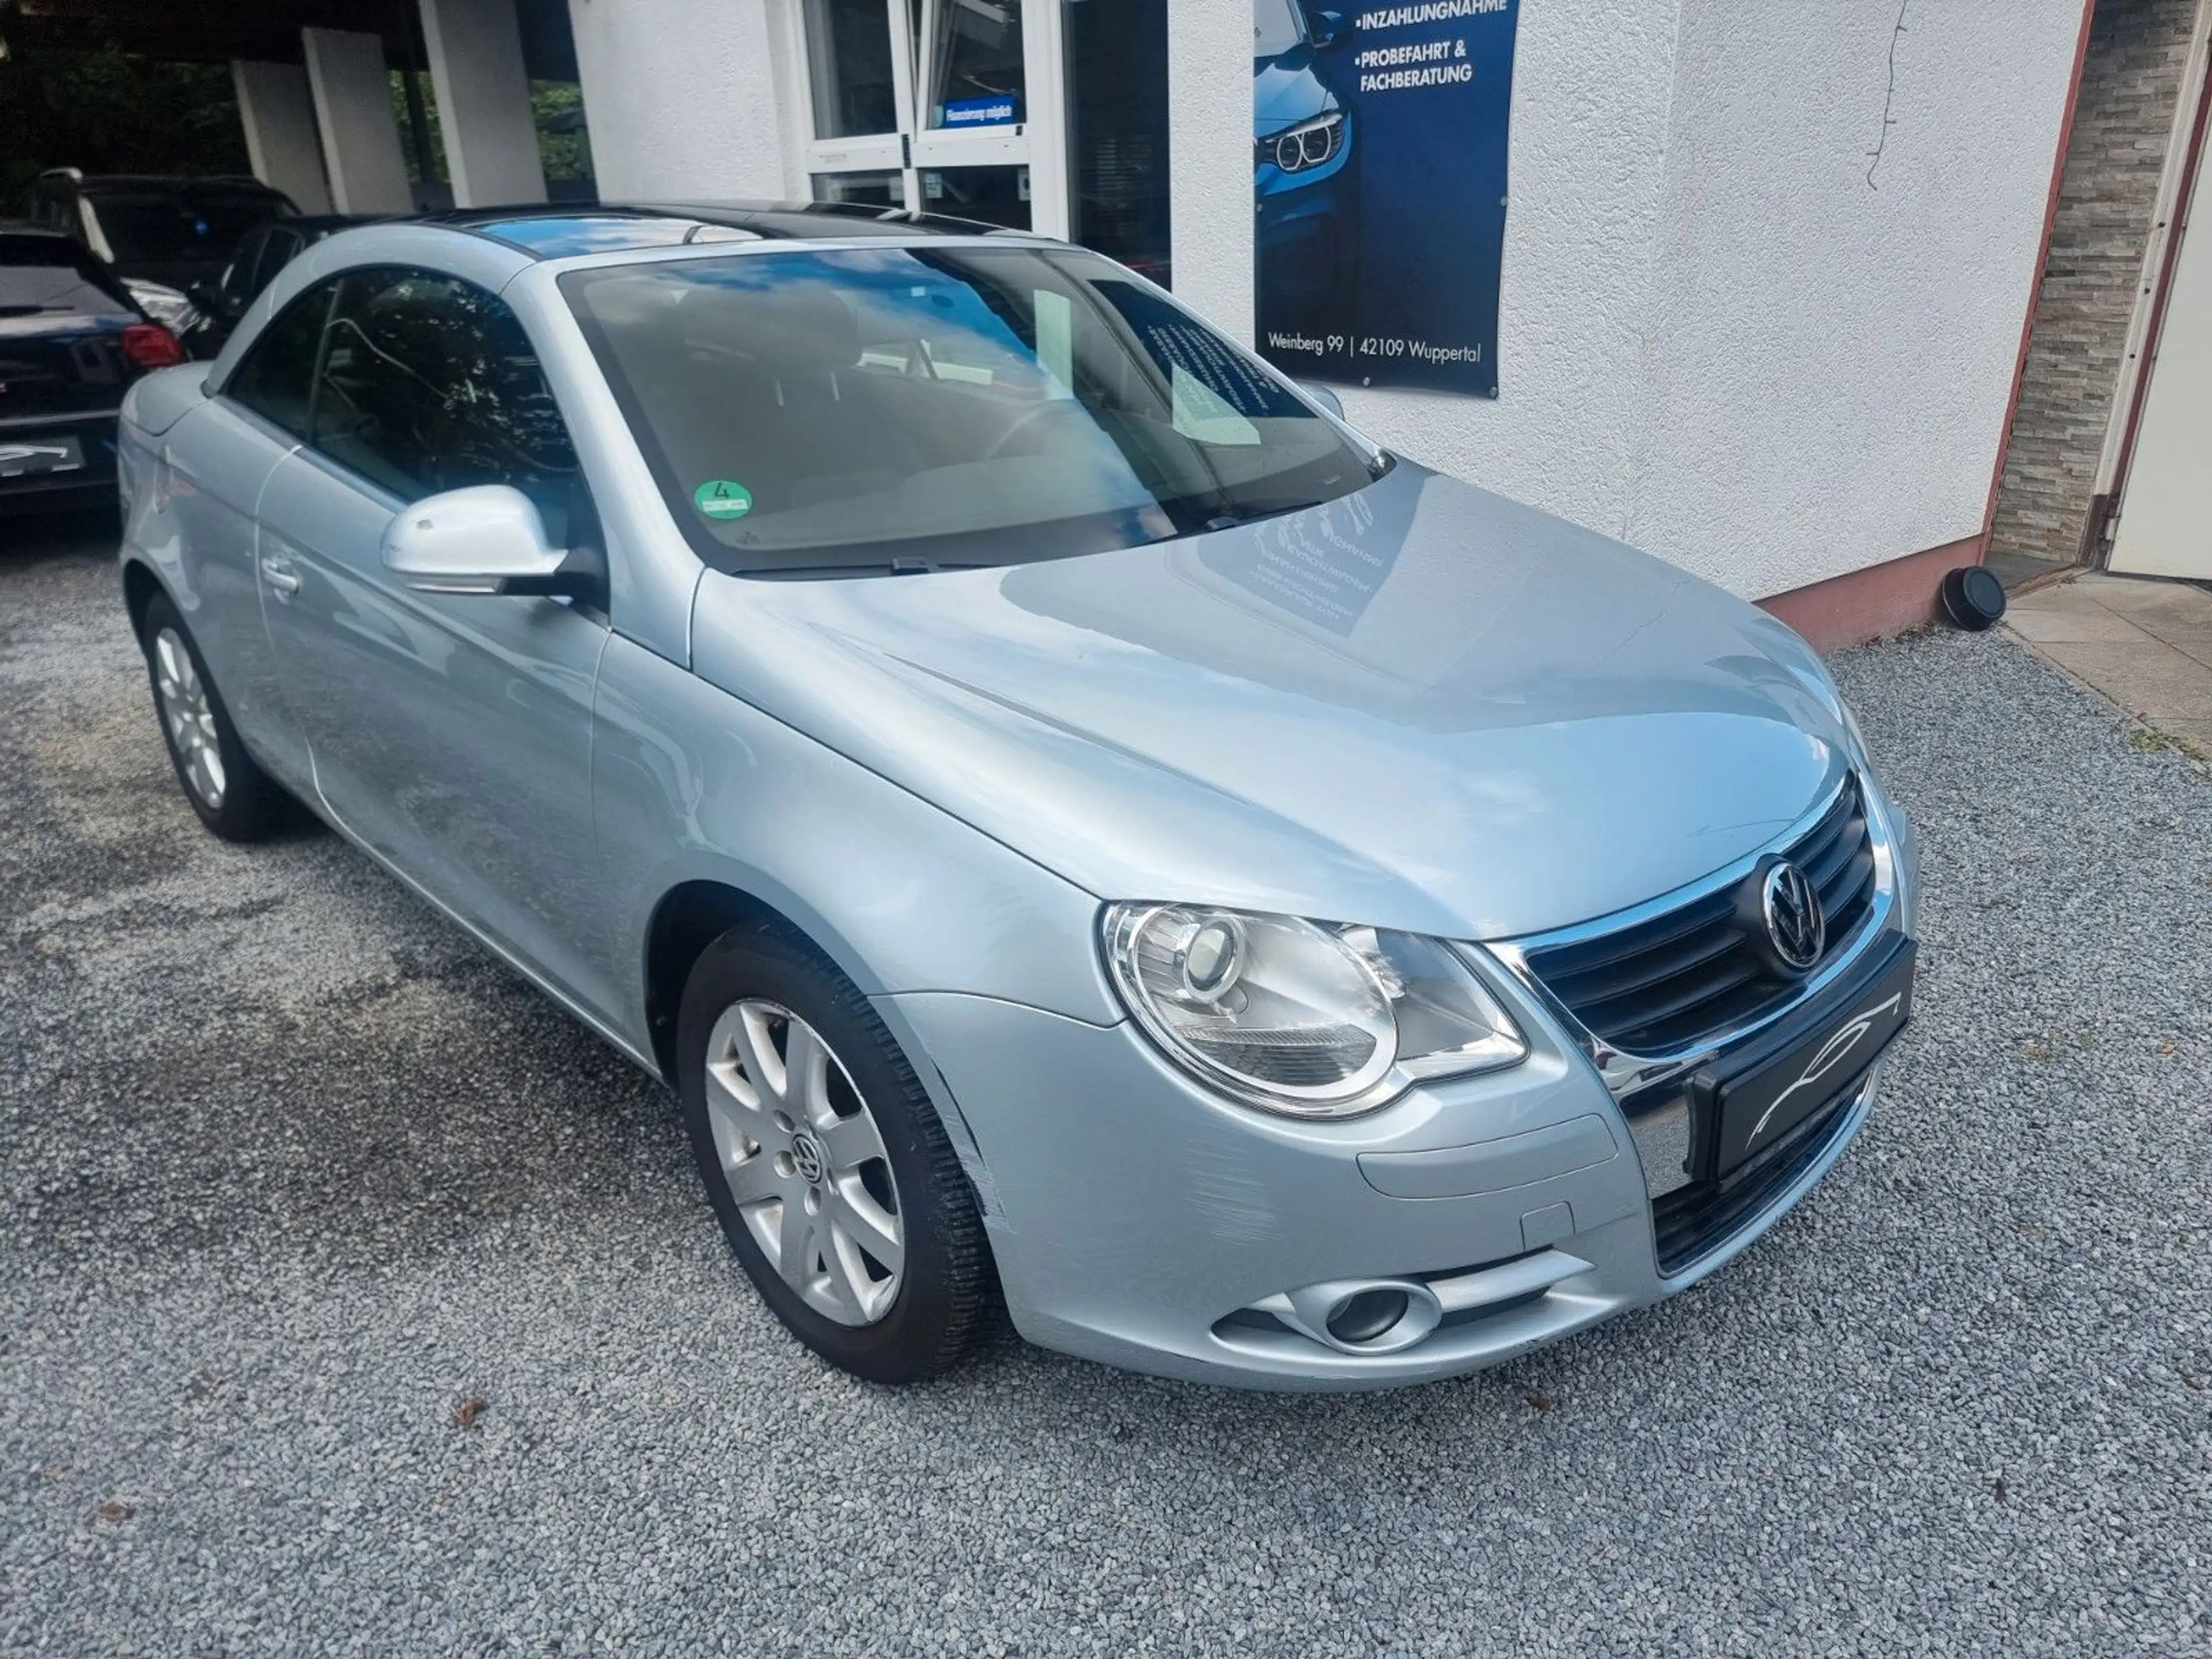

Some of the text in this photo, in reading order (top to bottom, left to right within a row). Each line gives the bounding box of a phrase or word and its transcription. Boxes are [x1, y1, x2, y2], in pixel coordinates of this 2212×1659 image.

[1362, 0, 1507, 29] INZAHLUNGNAHME
[1361, 39, 1467, 68] PROBEFAHRT &
[1360, 63, 1472, 92] FACHBERATUNG
[1268, 332, 1323, 356] Weinberg
[1327, 336, 1344, 352] 99
[1359, 338, 1404, 356] 42109
[1408, 341, 1481, 365] Wuppertal
[714, 482, 730, 499] 4
